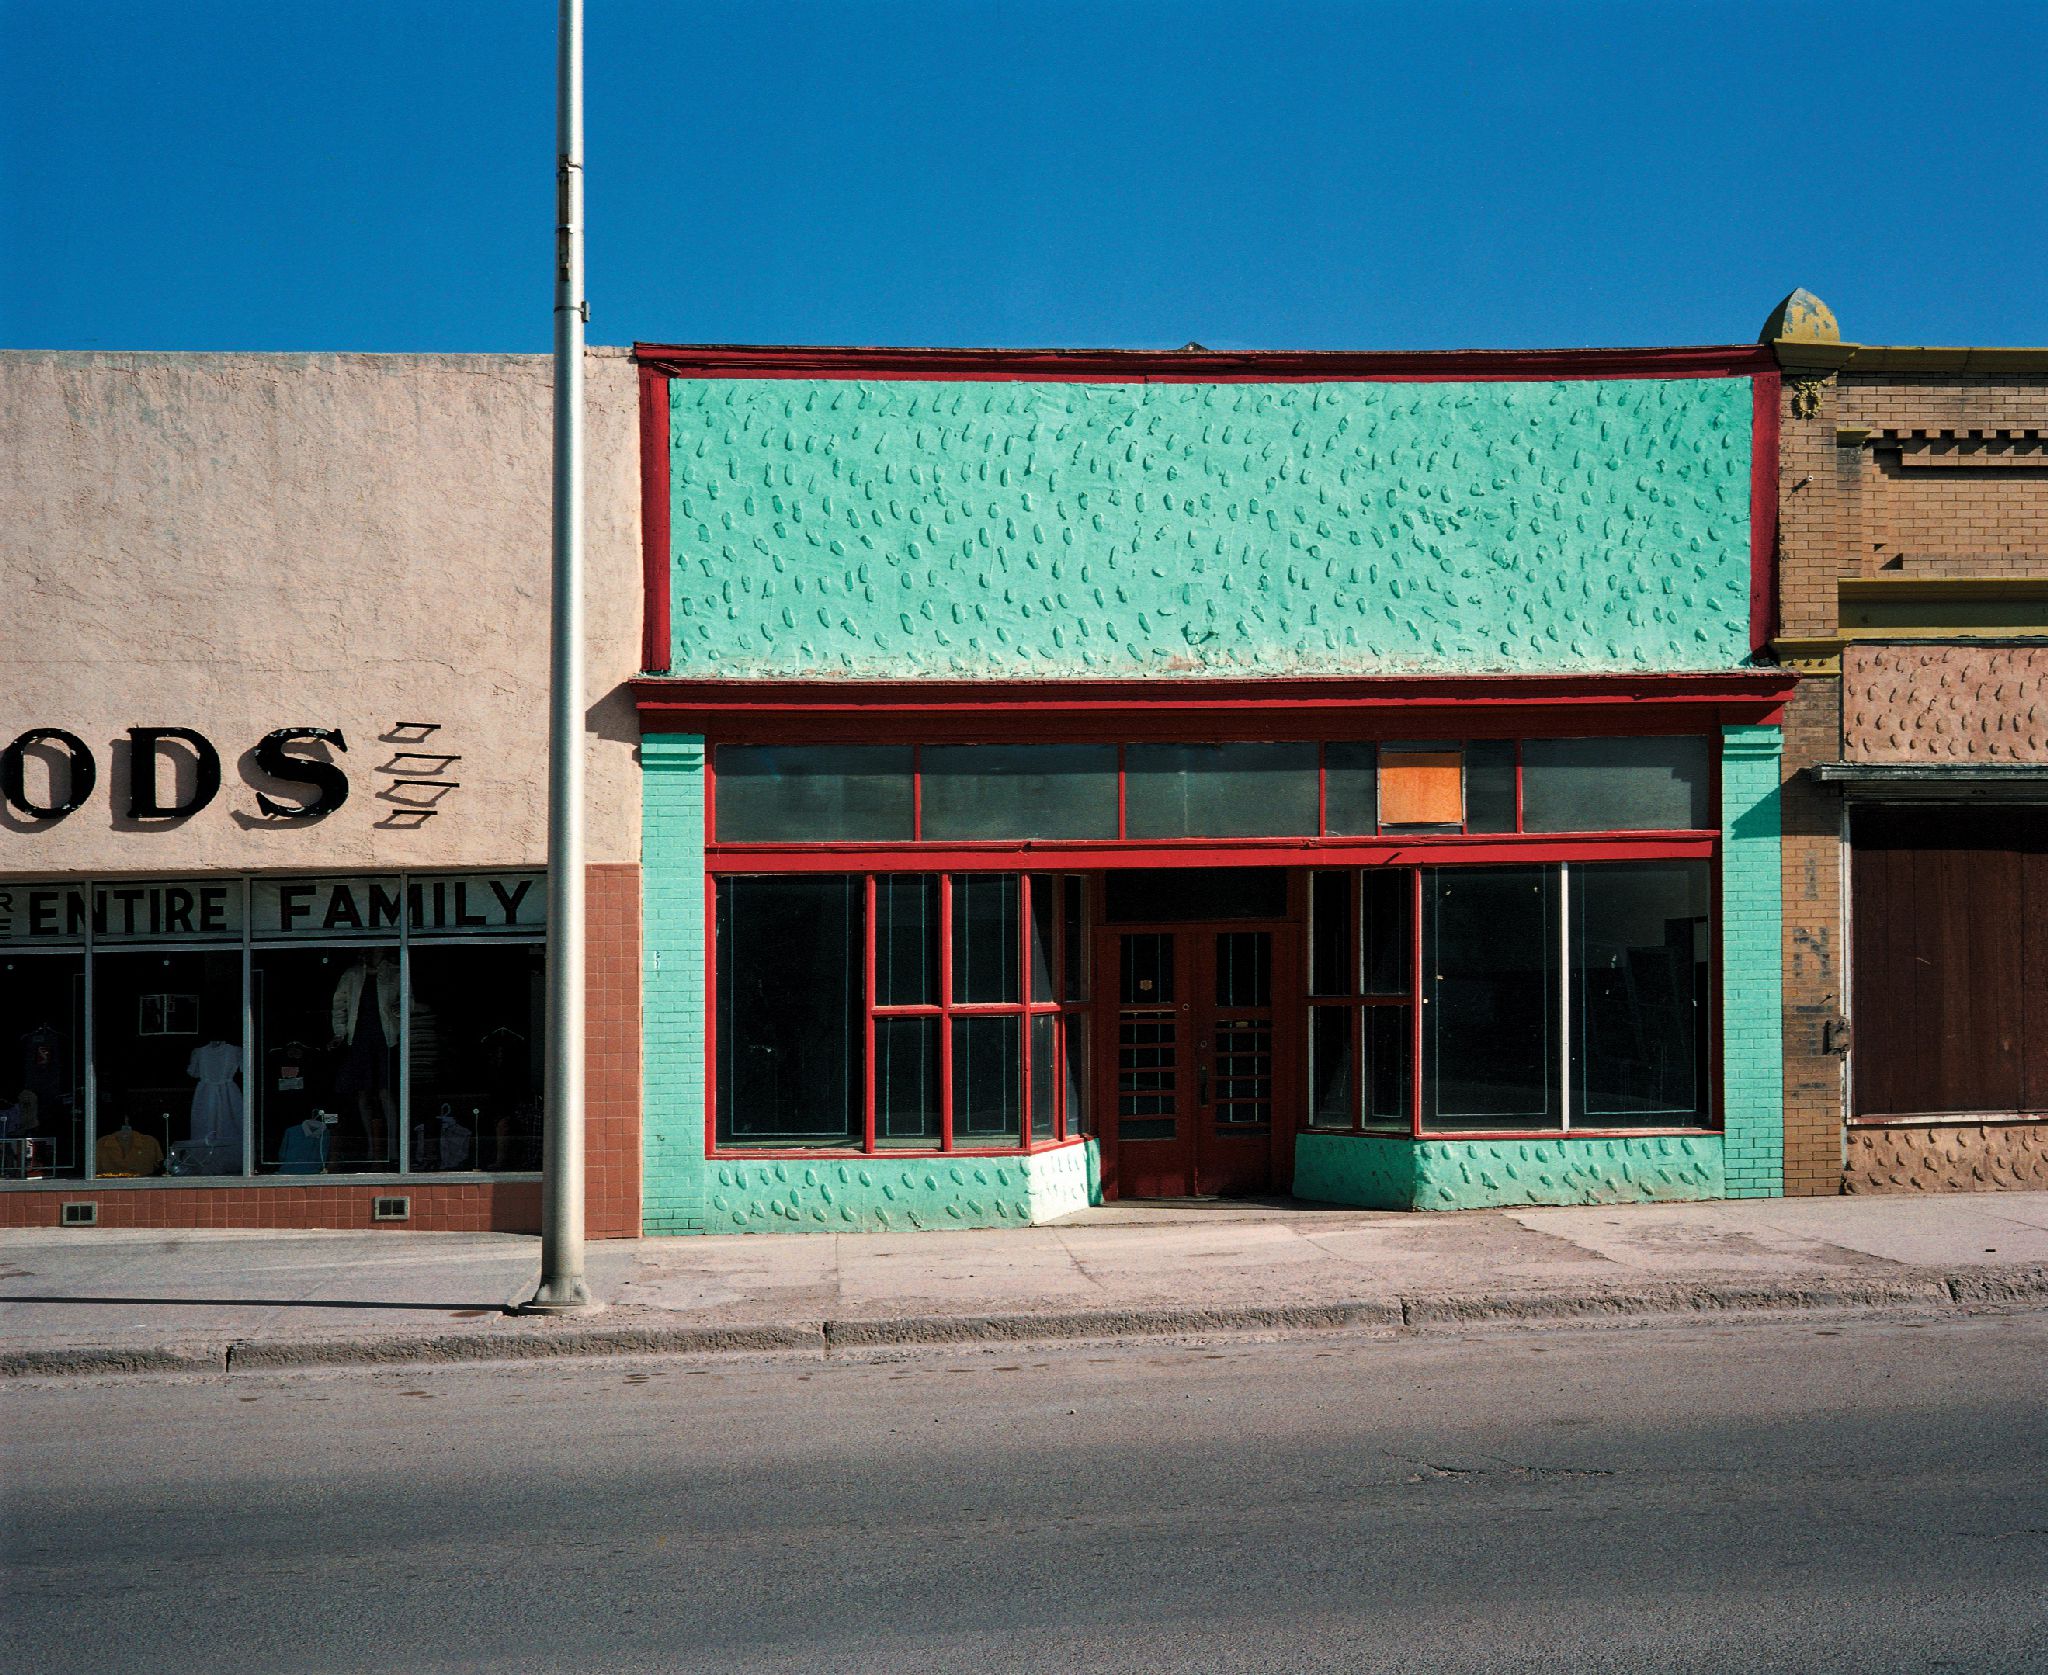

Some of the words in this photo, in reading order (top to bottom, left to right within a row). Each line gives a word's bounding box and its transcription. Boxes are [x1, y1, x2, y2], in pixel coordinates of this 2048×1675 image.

[0, 727, 349, 819] ODS
[29, 887, 227, 936] ENTIRE
[280, 880, 533, 932] FAMILY
